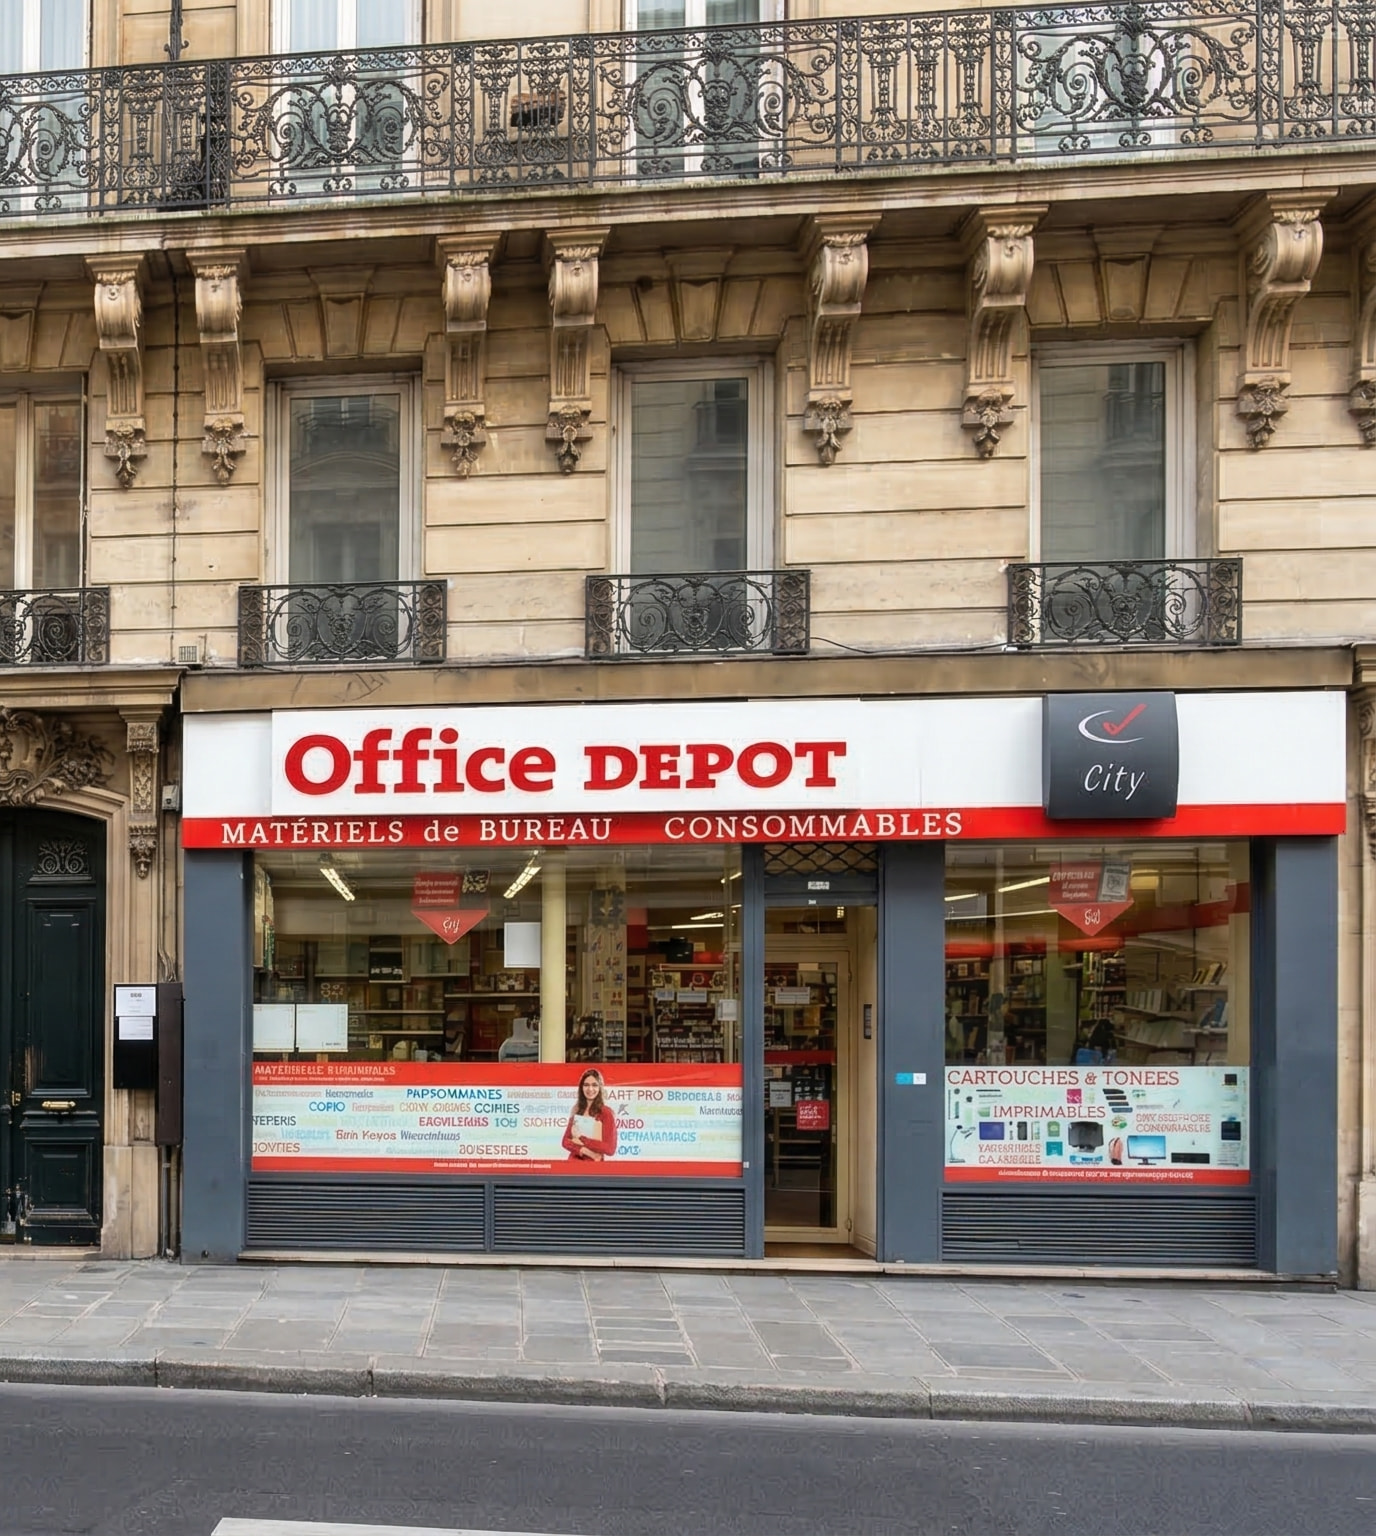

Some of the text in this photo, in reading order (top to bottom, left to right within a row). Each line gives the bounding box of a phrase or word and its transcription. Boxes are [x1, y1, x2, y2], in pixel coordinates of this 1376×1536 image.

[285, 728, 847, 796] Office DEPOT
[1084, 763, 1146, 800] City
[221, 812, 963, 844] MATÉRIELS de BUREAU CONSOMMABLES
[947, 1070, 1180, 1085] CARTOUCHES & TONEES
[637, 1089, 664, 1101] PRO
[994, 1105, 1106, 1118] IMPRIMABLES
